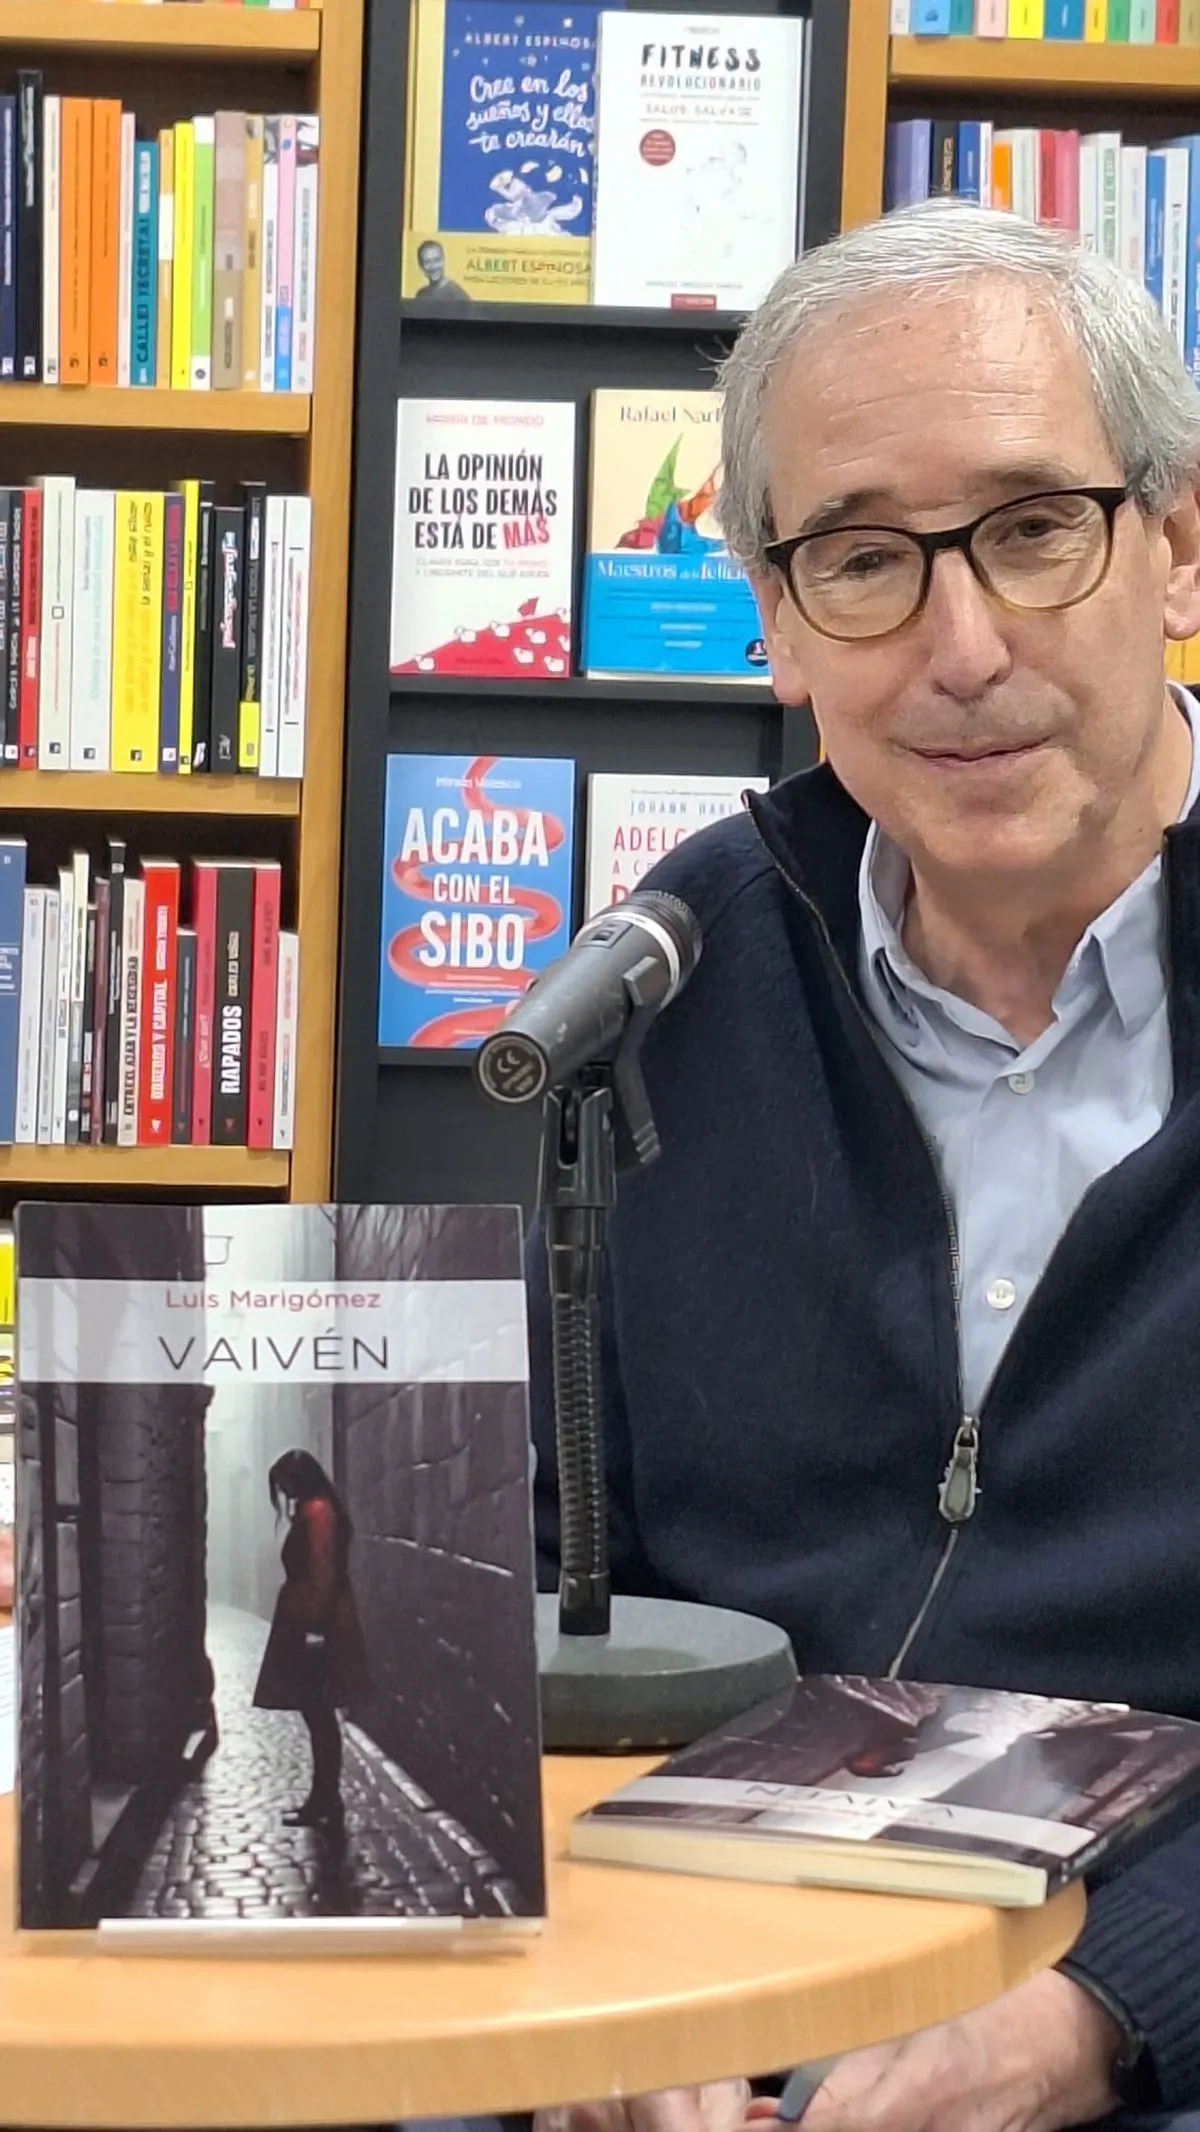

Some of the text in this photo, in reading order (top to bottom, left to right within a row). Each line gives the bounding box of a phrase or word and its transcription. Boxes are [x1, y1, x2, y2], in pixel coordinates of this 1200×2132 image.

[525, 34, 596, 49] ESPINOS
[641, 43, 761, 72] FITNESS
[470, 68, 588, 103] Cree en los
[640, 75, 761, 91] REVOLUCIONARIO
[465, 100, 531, 131] sueños
[532, 103, 550, 132] y
[468, 128, 586, 158] te crearán
[466, 258, 517, 273] ALBERT
[620, 406, 676, 422] Rafael
[425, 448, 543, 482] LA OPINIÓN
[409, 483, 557, 517] DE LOS DEMÁS
[415, 517, 464, 549] ESTÁ
[472, 522, 497, 549] DE
[630, 800, 687, 816] JOHANN
[401, 807, 549, 867] ACABA
[612, 860, 621, 875] A
[433, 873, 515, 905] CON EL
[419, 911, 525, 970] SIBO
[220, 1005, 243, 1094] RAPADOS
[166, 1289, 381, 1311] Luis Marigómez
[158, 1327, 388, 1371] VAIVÉN
